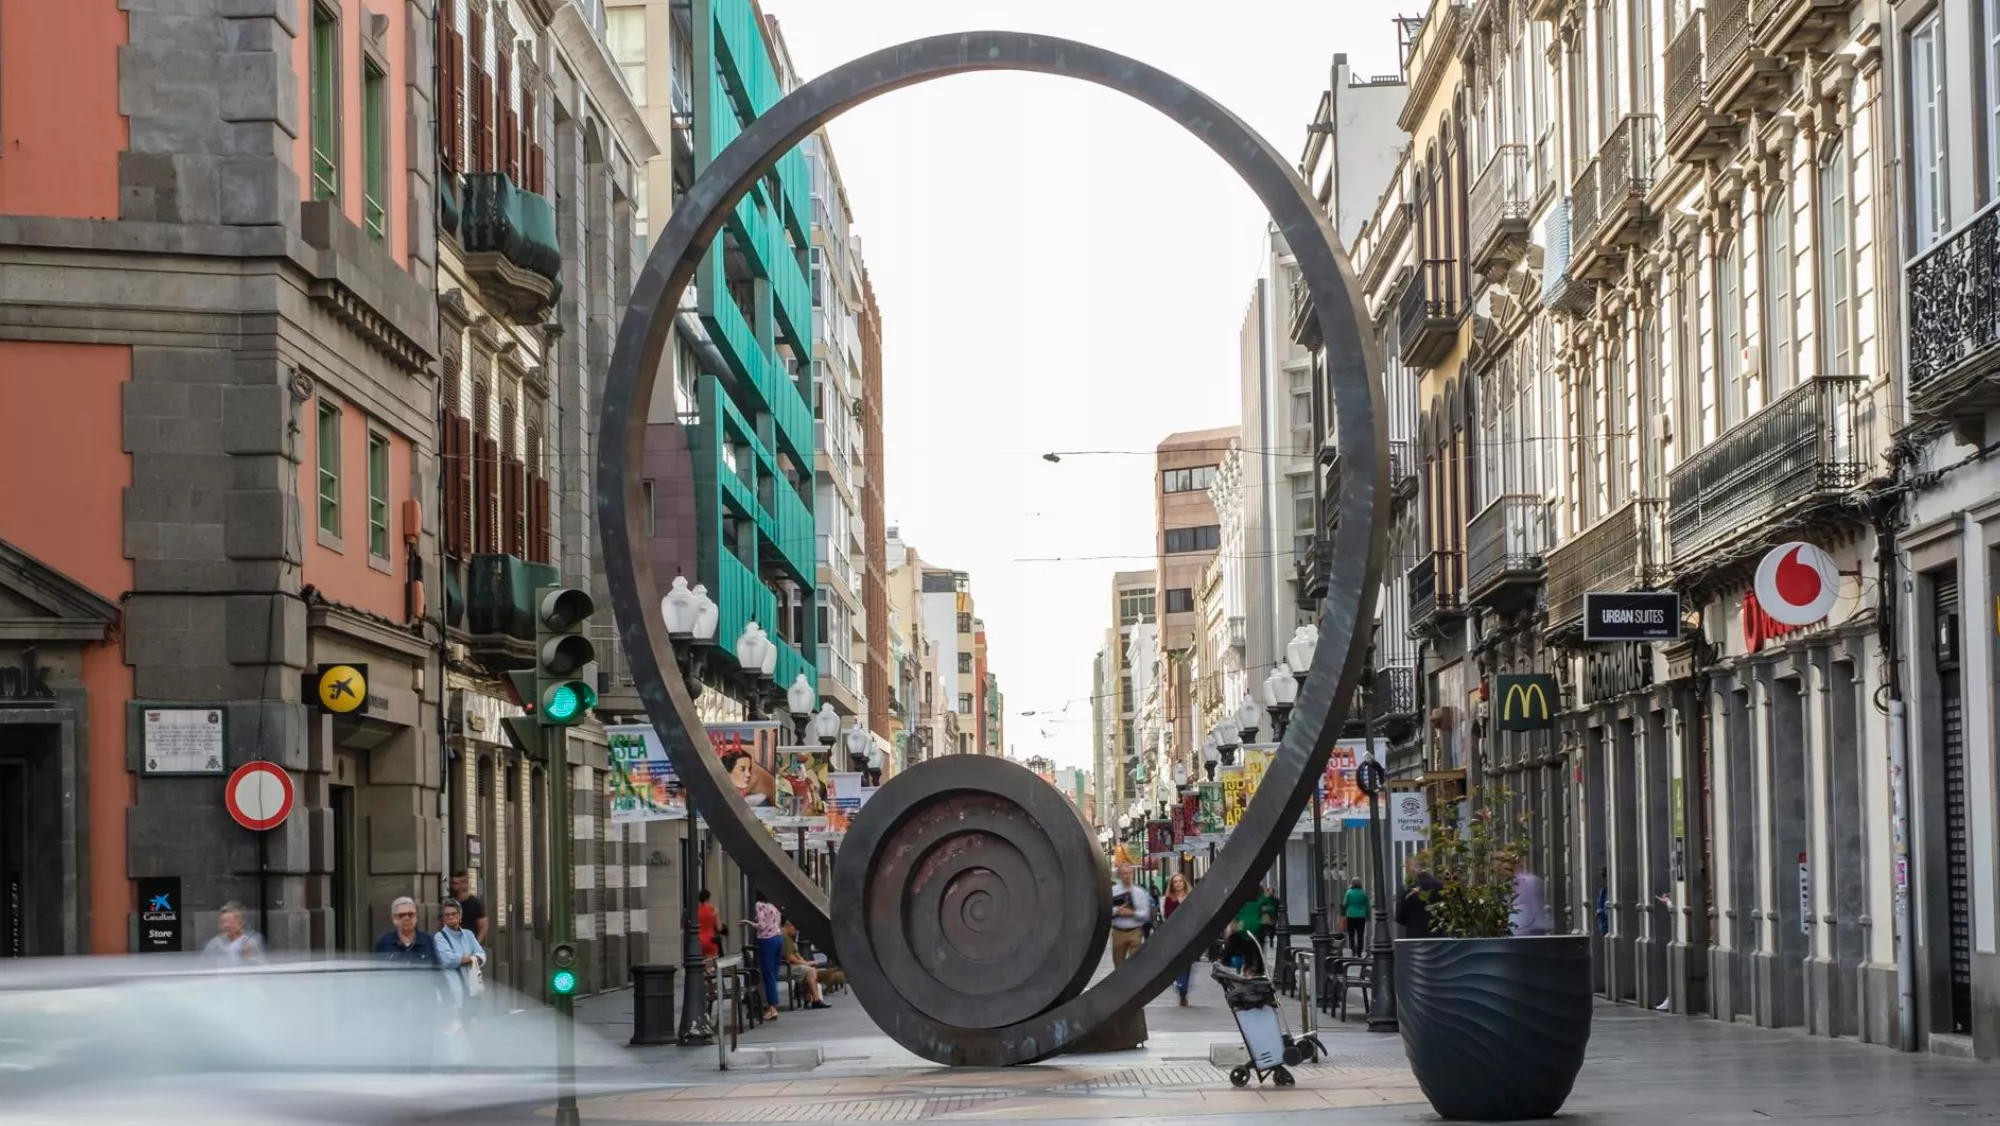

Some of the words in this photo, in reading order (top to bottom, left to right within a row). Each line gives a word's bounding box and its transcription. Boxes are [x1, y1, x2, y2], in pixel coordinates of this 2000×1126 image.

[1602, 609, 1633, 624] URBAN
[1635, 609, 1664, 624] SUITES
[708, 730, 742, 757] SLA
[1330, 746, 1357, 768] SLA
[148, 929, 173, 938] Store
